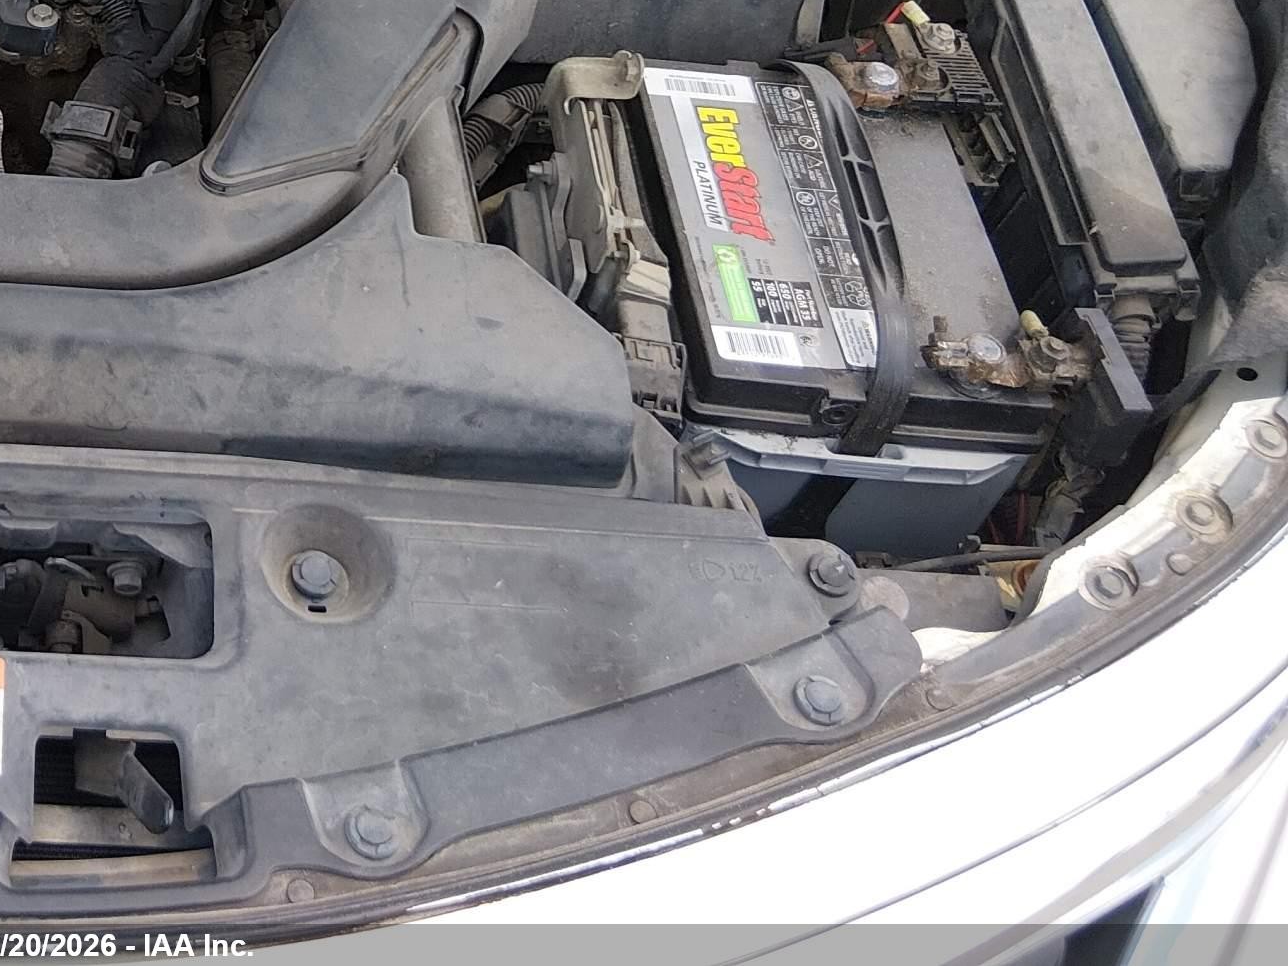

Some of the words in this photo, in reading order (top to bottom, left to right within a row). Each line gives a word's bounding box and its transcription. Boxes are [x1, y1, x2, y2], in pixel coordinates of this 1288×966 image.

[696, 106, 775, 241] EverStart
[693, 160, 722, 225] PLATINUM
[751, 281, 763, 292] 55
[765, 282, 778, 297] 100
[778, 283, 792, 300] 650
[793, 289, 808, 308] AGM
